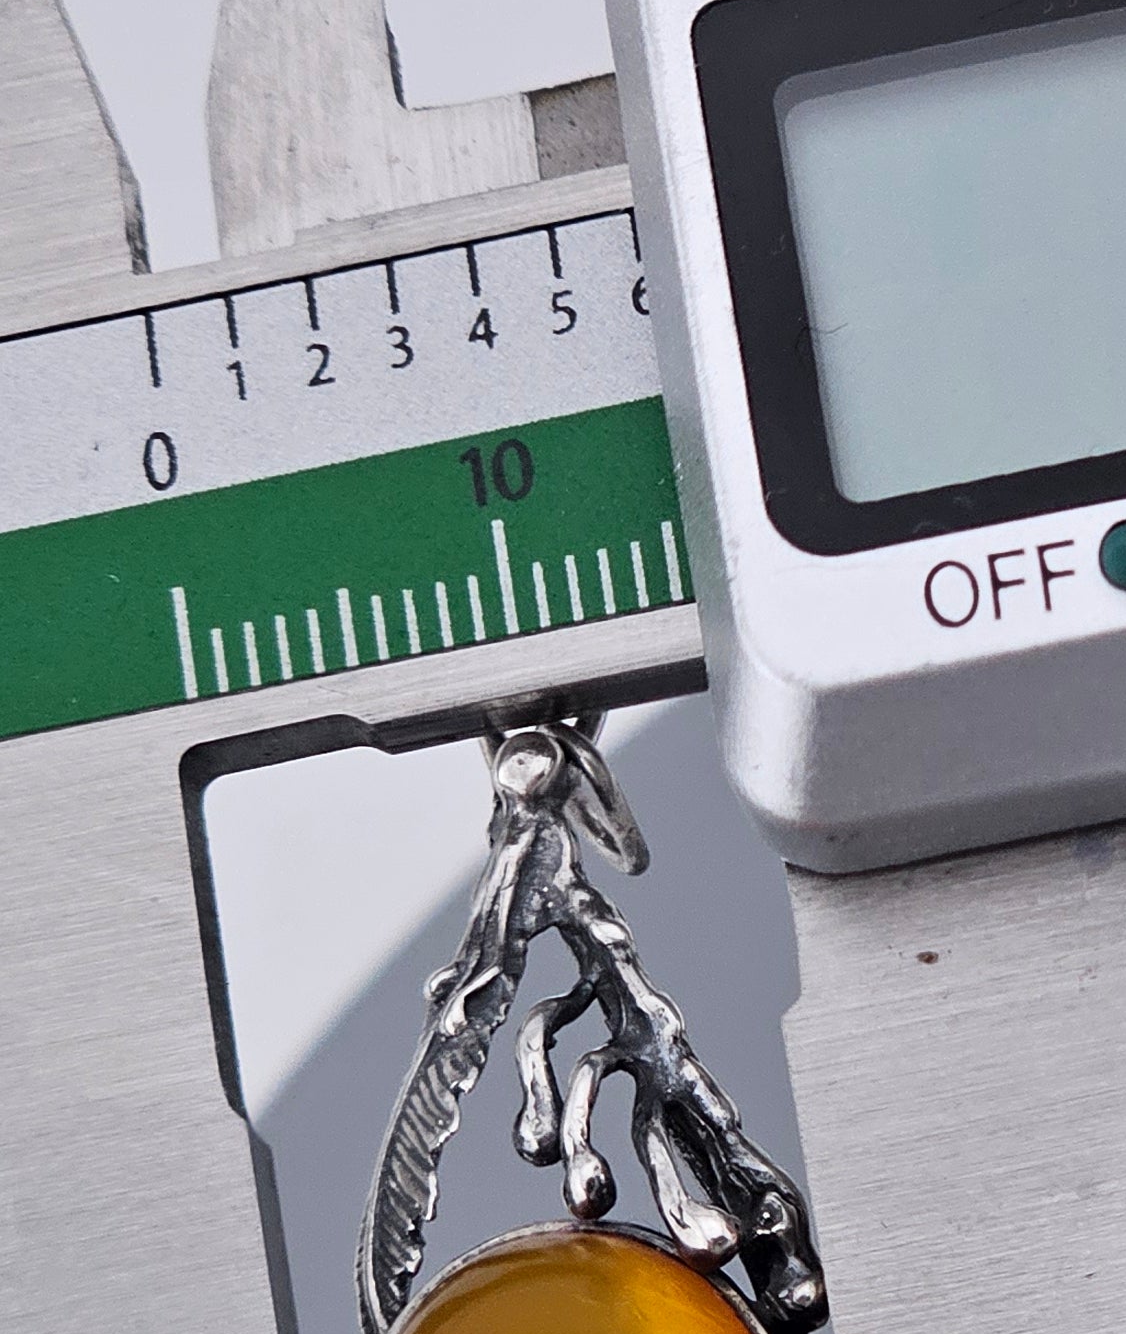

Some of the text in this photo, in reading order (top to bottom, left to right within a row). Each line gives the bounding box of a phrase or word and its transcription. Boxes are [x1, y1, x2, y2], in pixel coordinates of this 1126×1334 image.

[227, 361, 247, 400] 1
[308, 343, 335, 386] 2
[386, 326, 414, 368] 3
[469, 308, 498, 349] 4
[550, 291, 576, 335] 5
[143, 431, 178, 490] 0
[460, 438, 535, 508] 10
[923, 539, 1076, 628] OFF
